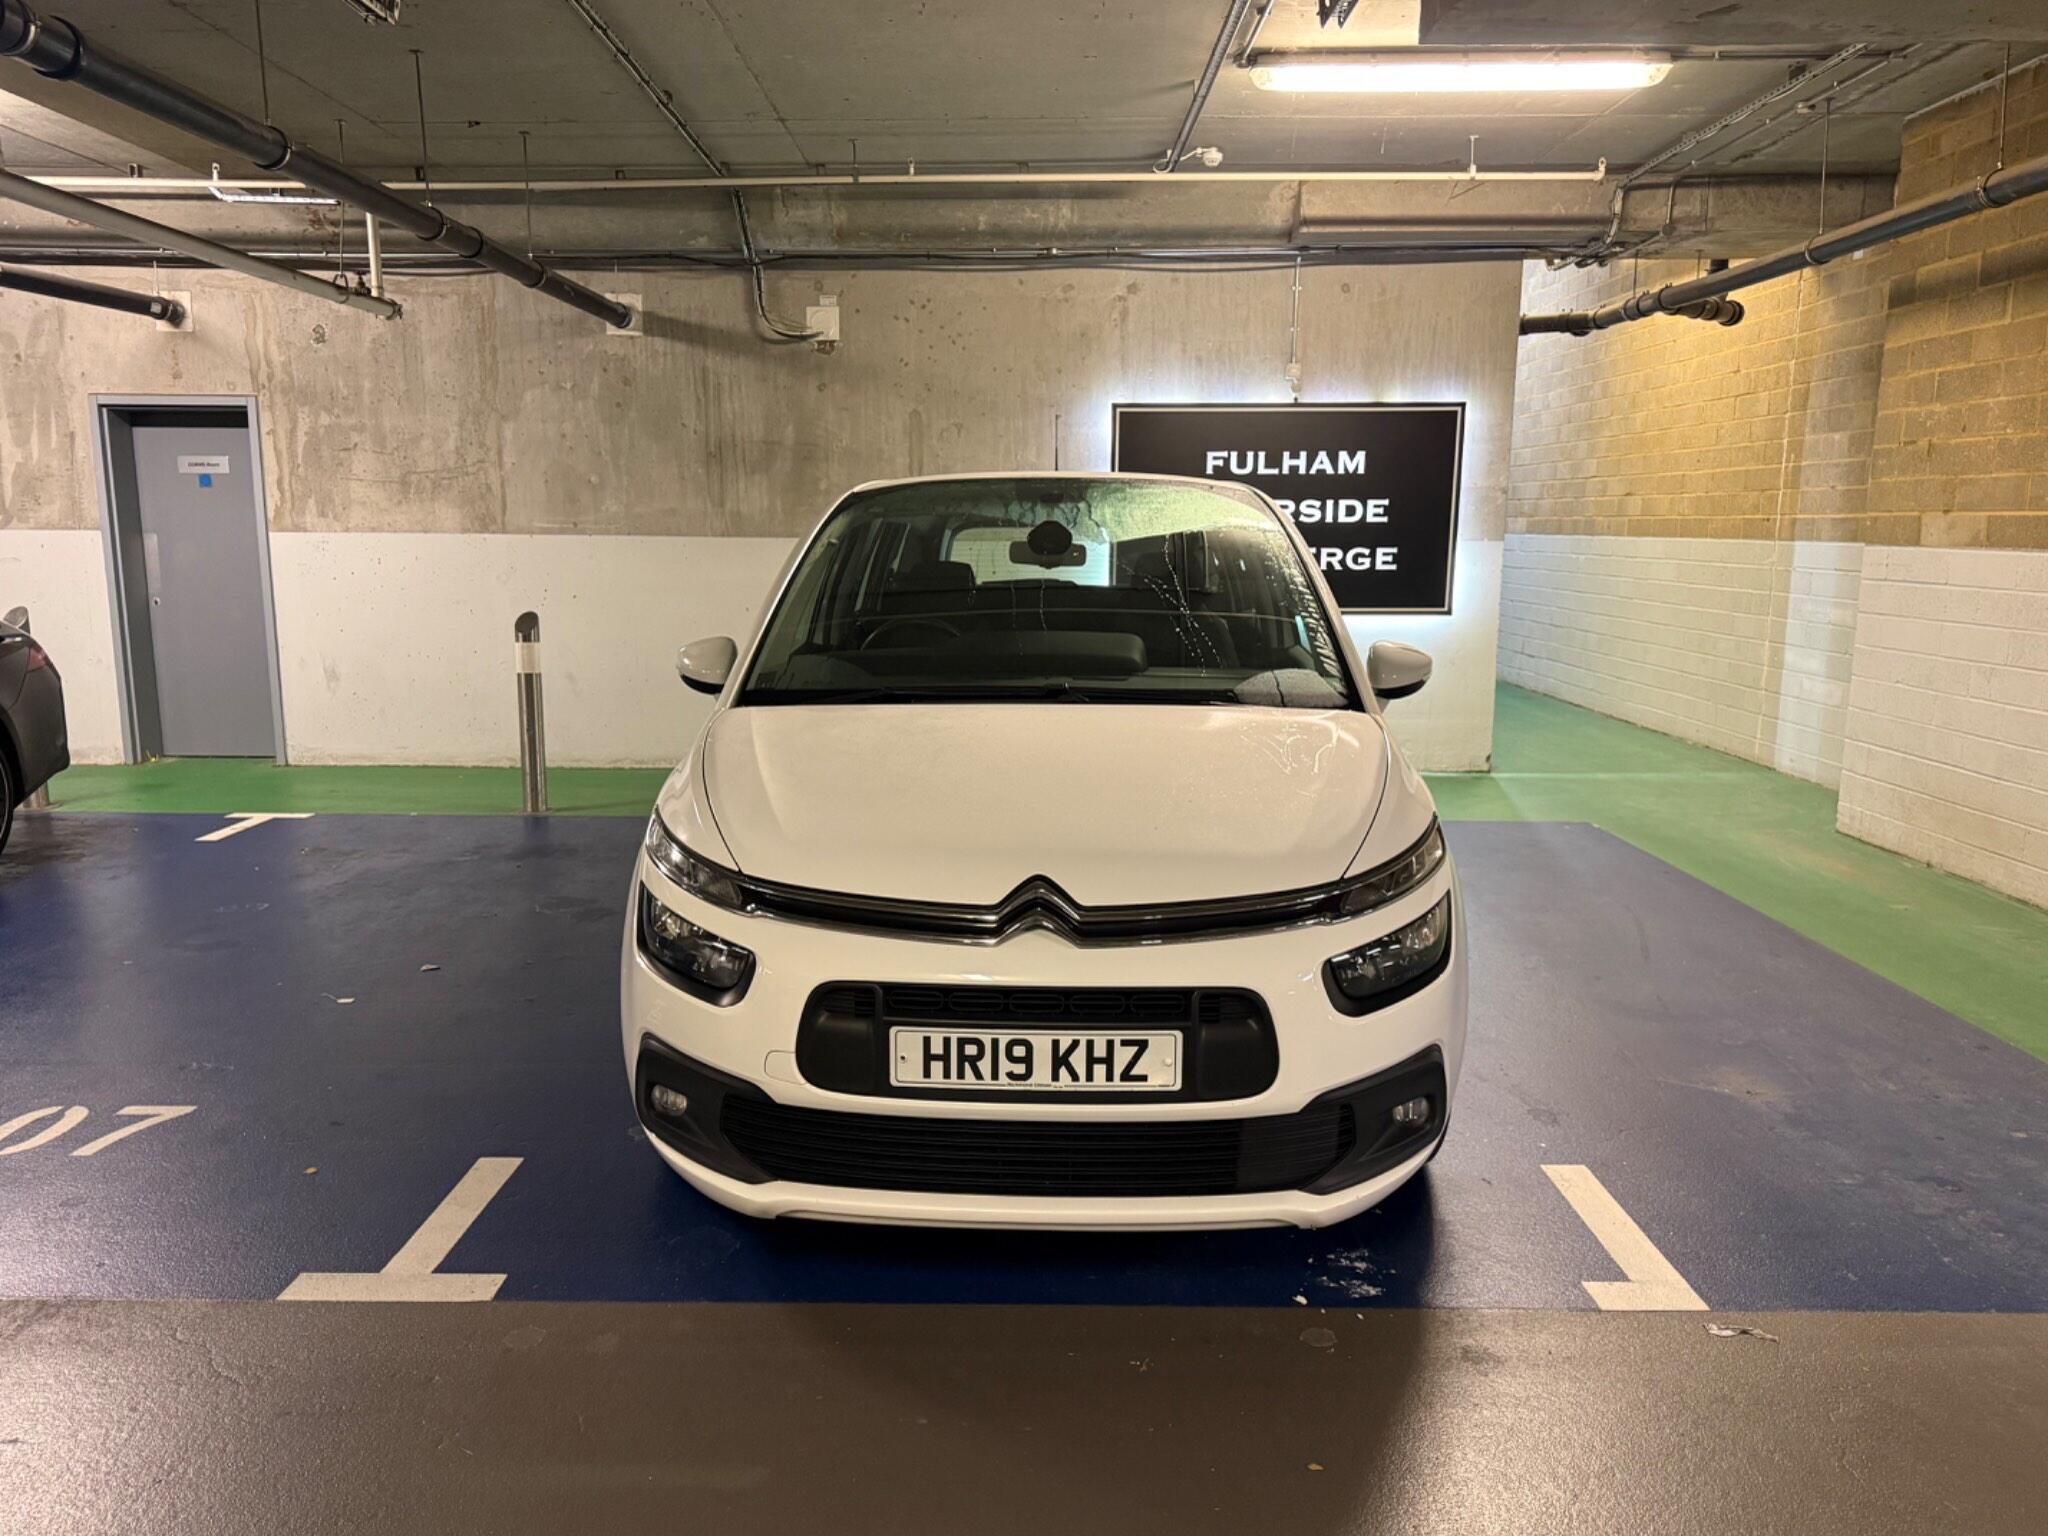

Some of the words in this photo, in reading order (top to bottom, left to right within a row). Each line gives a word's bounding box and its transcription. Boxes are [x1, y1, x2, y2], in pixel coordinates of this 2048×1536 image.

[1205, 450, 1367, 475] FULHAM
[1273, 498, 1390, 523] RSIDE
[922, 1035, 1034, 1082] HR19
[1051, 1038, 1149, 1083] KHZ
